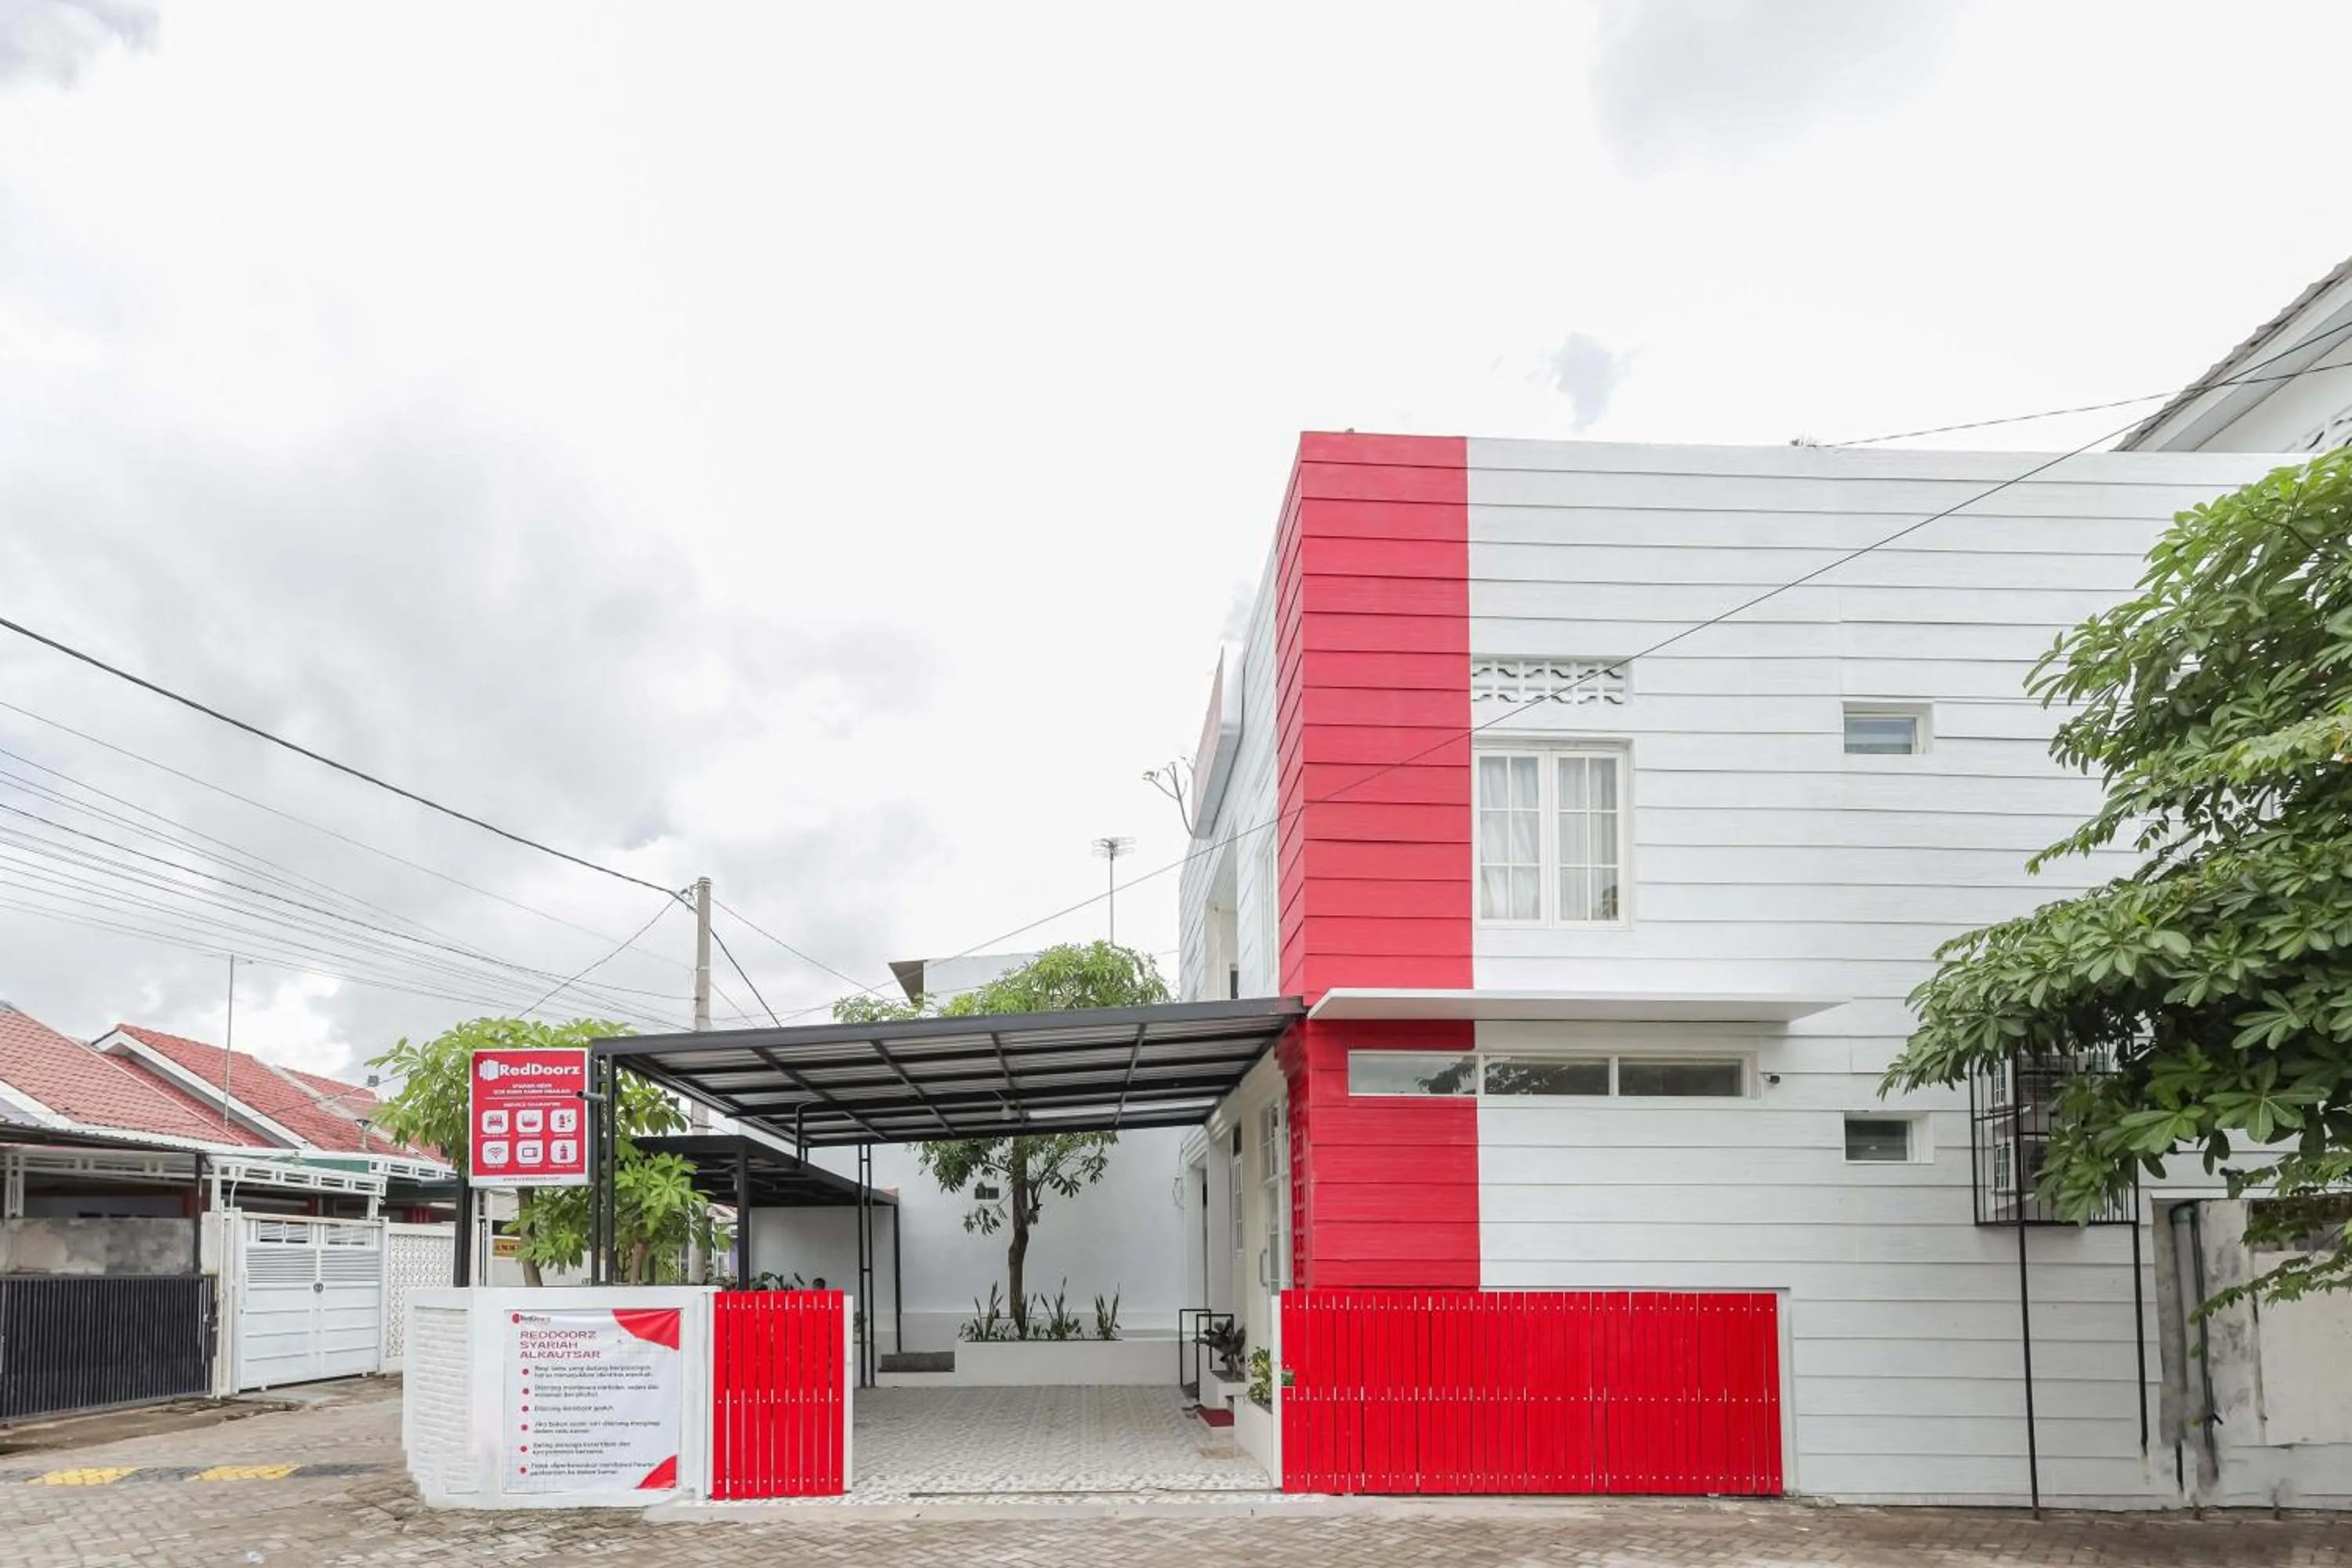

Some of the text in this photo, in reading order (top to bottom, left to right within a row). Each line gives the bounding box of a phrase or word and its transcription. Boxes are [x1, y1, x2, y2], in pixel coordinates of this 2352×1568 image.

[499, 1062, 582, 1076] RedDoorz
[520, 1330, 597, 1339] REDDOORZ
[520, 1341, 579, 1349] SYARIAH
[520, 1350, 601, 1359] ALKAUTSAR
